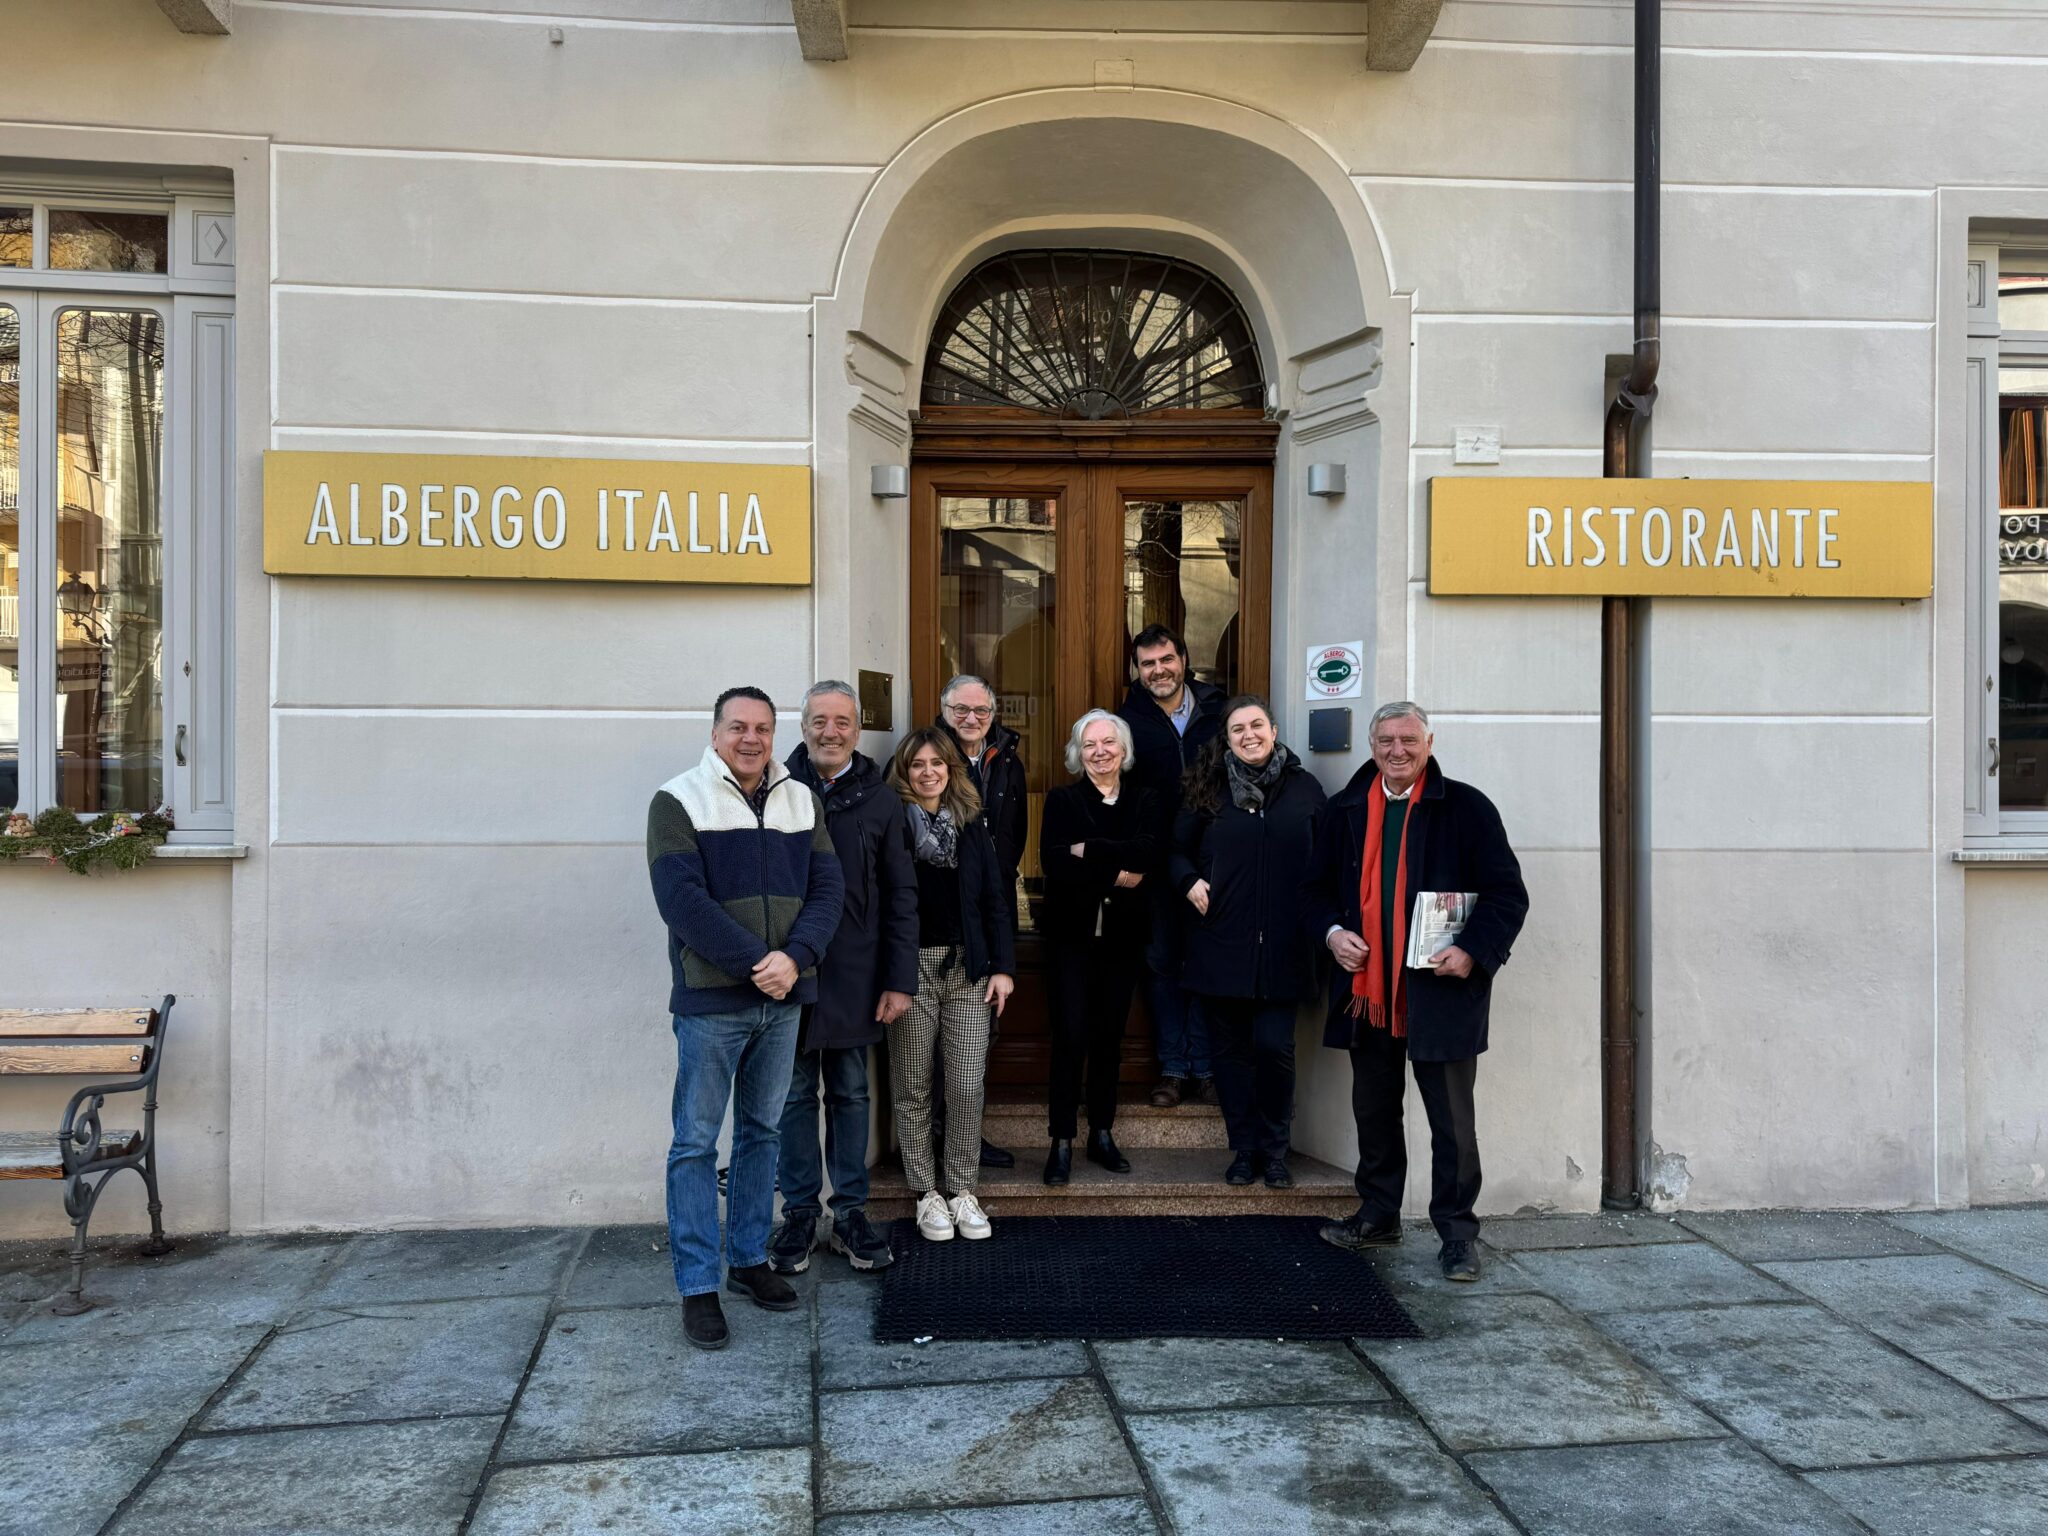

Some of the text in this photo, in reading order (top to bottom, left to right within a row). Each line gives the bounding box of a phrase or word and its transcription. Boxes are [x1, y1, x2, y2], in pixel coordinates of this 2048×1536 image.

[304, 482, 772, 555] ALBERGO ITALIA
[1527, 507, 1841, 568] RISTORANTE
[1323, 650, 1346, 659] ALBERGO
